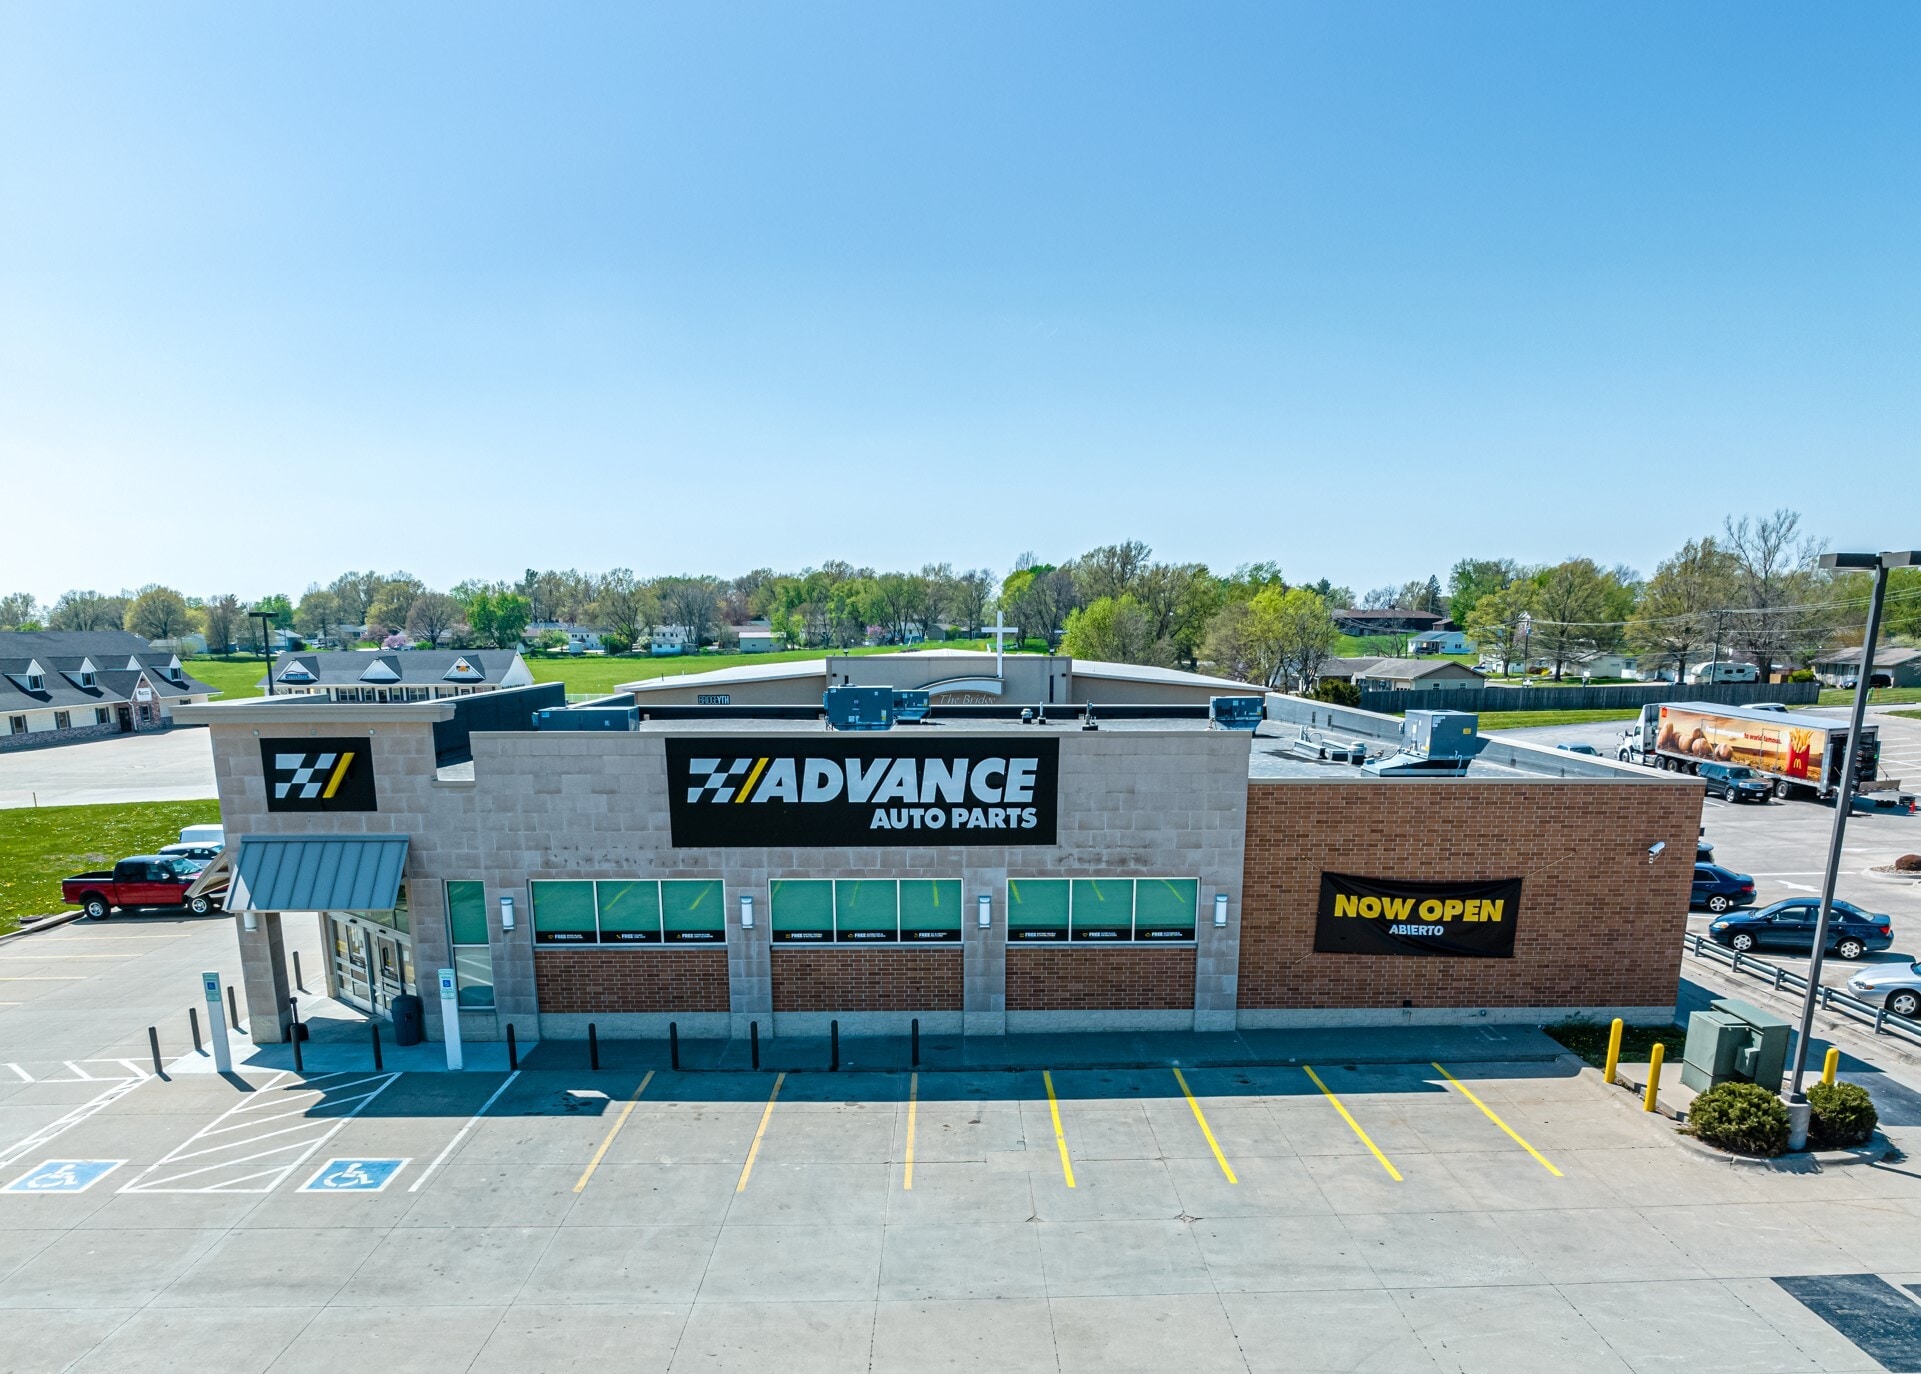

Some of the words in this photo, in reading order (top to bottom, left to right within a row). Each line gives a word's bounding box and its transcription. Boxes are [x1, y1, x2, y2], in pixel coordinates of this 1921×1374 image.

[940, 694, 960, 705] The
[963, 694, 996, 705] Bridge
[750, 757, 1039, 804] ADVANCE
[870, 807, 946, 829] AUTO
[951, 807, 1038, 829] PARTS
[1334, 894, 1416, 920] NOW
[1418, 899, 1505, 922] OPEN
[1389, 924, 1444, 936] ABIERTO
